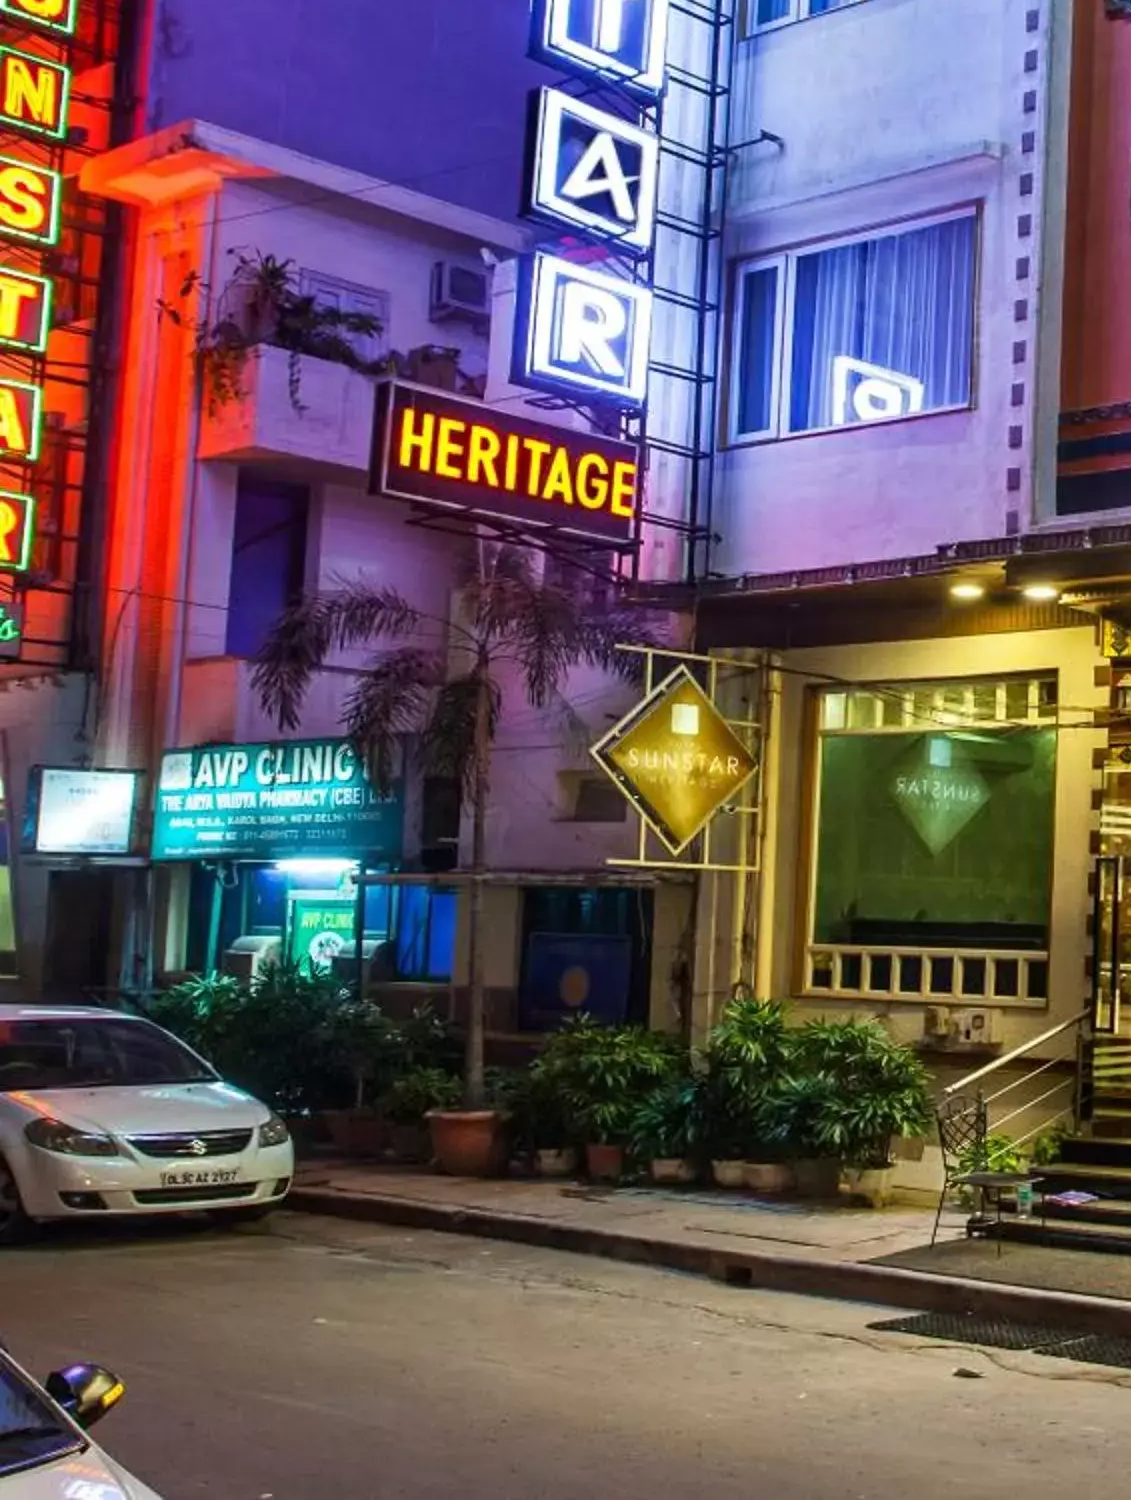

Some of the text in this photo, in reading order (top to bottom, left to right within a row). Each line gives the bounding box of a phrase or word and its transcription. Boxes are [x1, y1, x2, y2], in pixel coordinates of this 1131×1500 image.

[399, 406, 638, 519] HERITAGE
[193, 751, 249, 789] AVP
[255, 743, 356, 786] CLINIC
[628, 747, 739, 776] SUNSTAR
